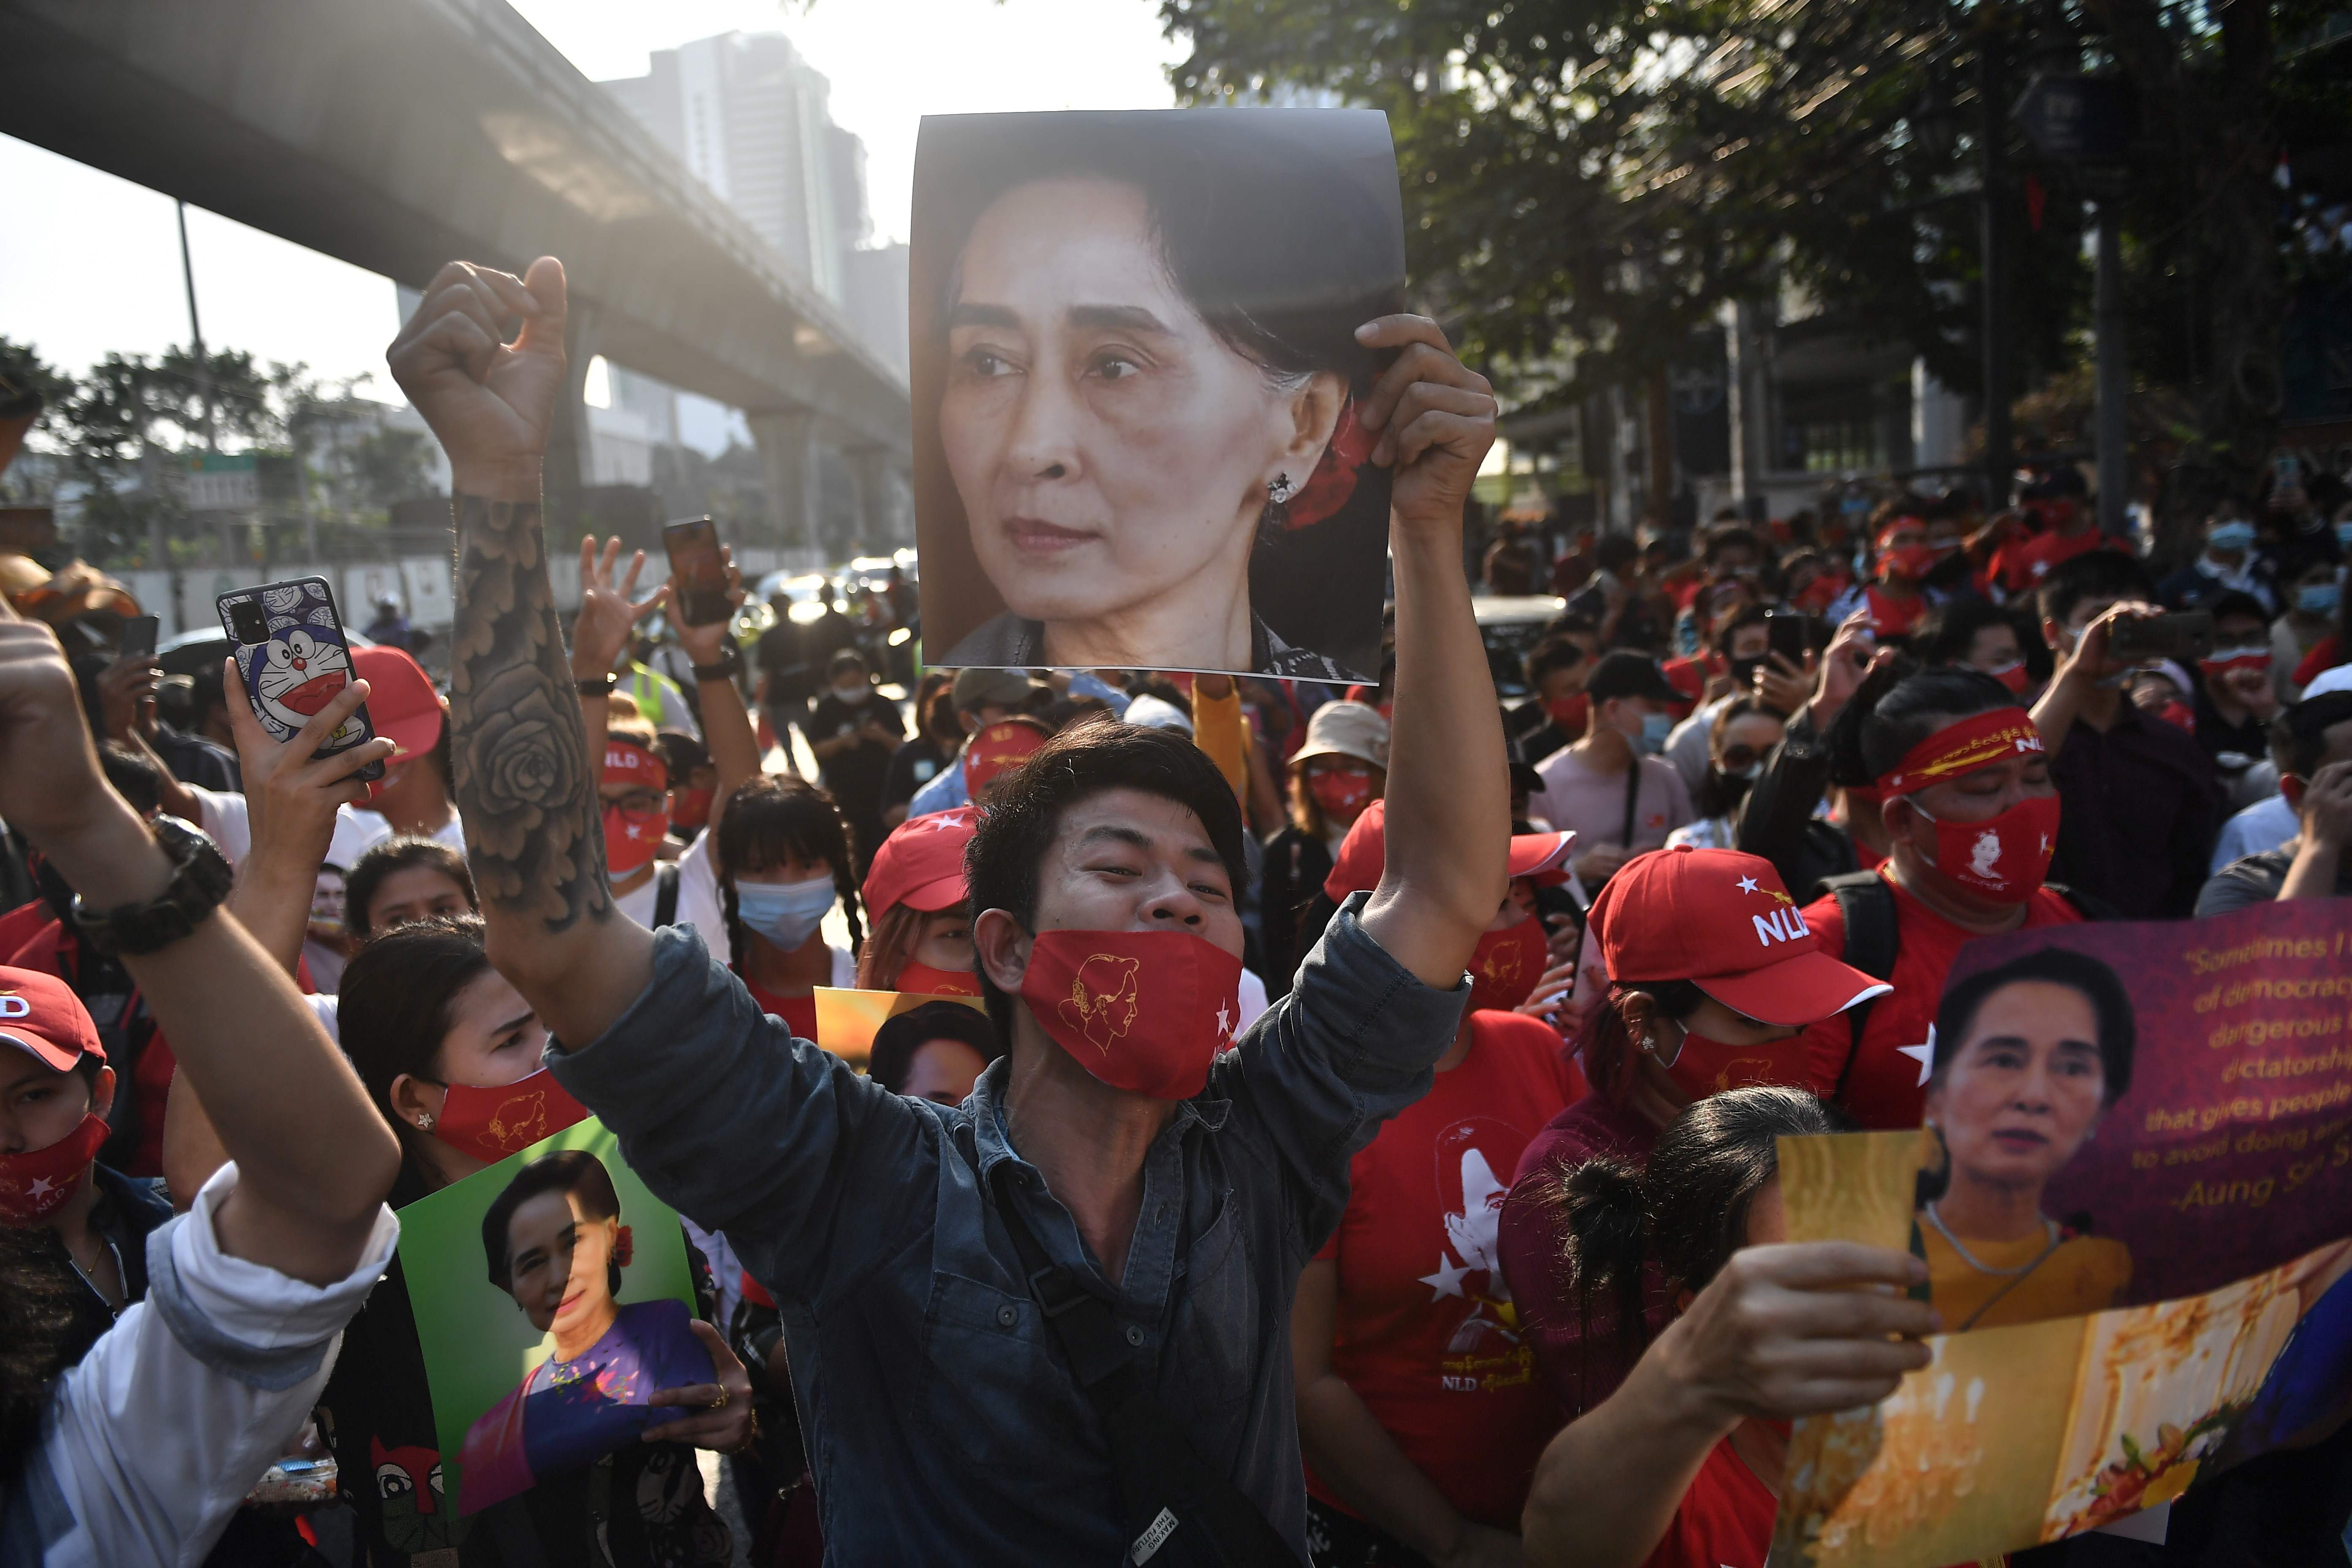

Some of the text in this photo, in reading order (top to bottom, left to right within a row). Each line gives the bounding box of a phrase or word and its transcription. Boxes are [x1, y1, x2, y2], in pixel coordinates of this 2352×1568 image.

[2015, 738, 2044, 753] NL
[2222, 1045, 2352, 1082] dictatorshi
[2146, 1108, 2195, 1132] that
[2133, 1151, 2159, 1169] to
[1442, 1375, 1477, 1391] NLD
[1155, 1514, 1170, 1530] THE
[1148, 1519, 1175, 1549] MAKING
